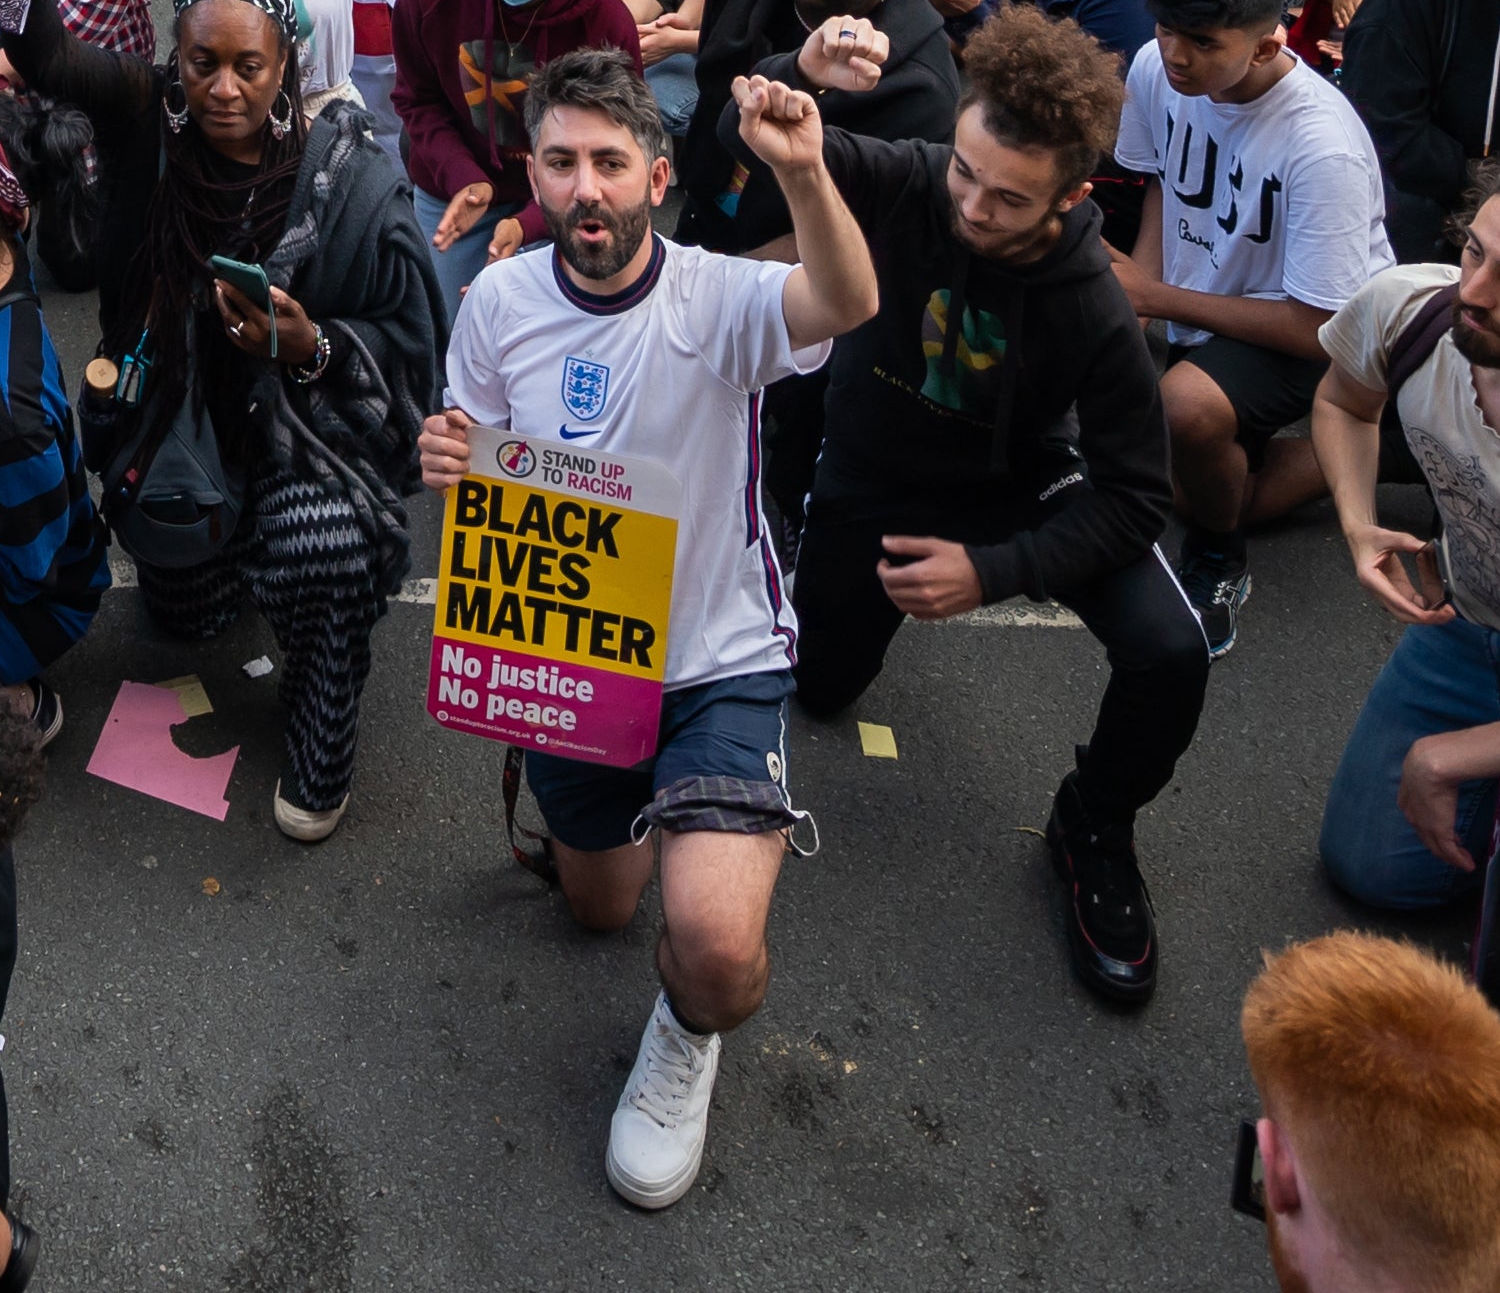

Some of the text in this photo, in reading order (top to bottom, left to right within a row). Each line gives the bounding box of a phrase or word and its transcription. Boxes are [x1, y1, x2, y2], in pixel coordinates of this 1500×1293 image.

[541, 466, 632, 501] TO RACISM
[542, 450, 624, 479] STAND UP
[454, 481, 623, 558] BLACK
[450, 531, 591, 601] LIVES
[445, 583, 655, 669] MATTER
[441, 645, 593, 703] No justice
[438, 678, 577, 732] No peace
